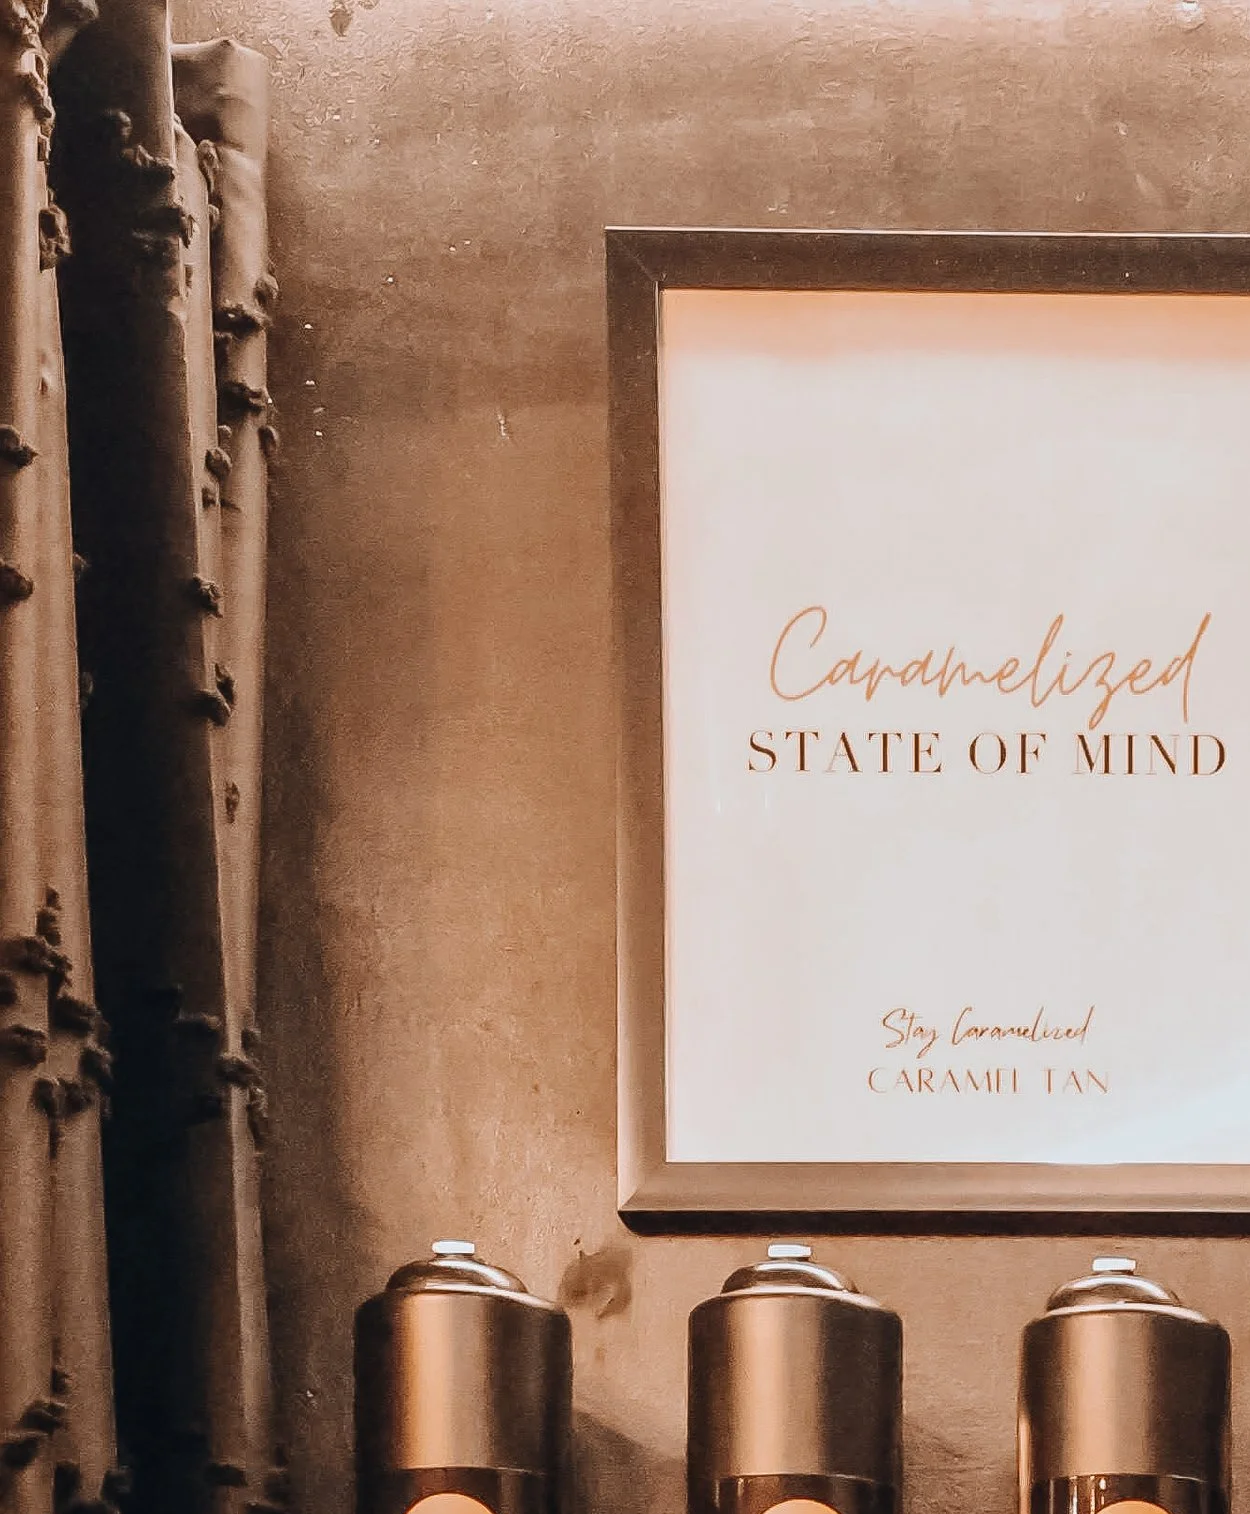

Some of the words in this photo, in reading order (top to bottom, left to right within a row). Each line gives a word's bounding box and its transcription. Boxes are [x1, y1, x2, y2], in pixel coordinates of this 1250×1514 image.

[771, 606, 1211, 726] Caramelized
[747, 730, 943, 774] STATE
[968, 731, 1047, 775] OF
[1073, 732, 1227, 776] MIND
[882, 1007, 939, 1059] Stay
[952, 1005, 1095, 1046] Caramelized
[868, 1067, 1022, 1094] CARAMEL
[1039, 1067, 1108, 1094] TAN
